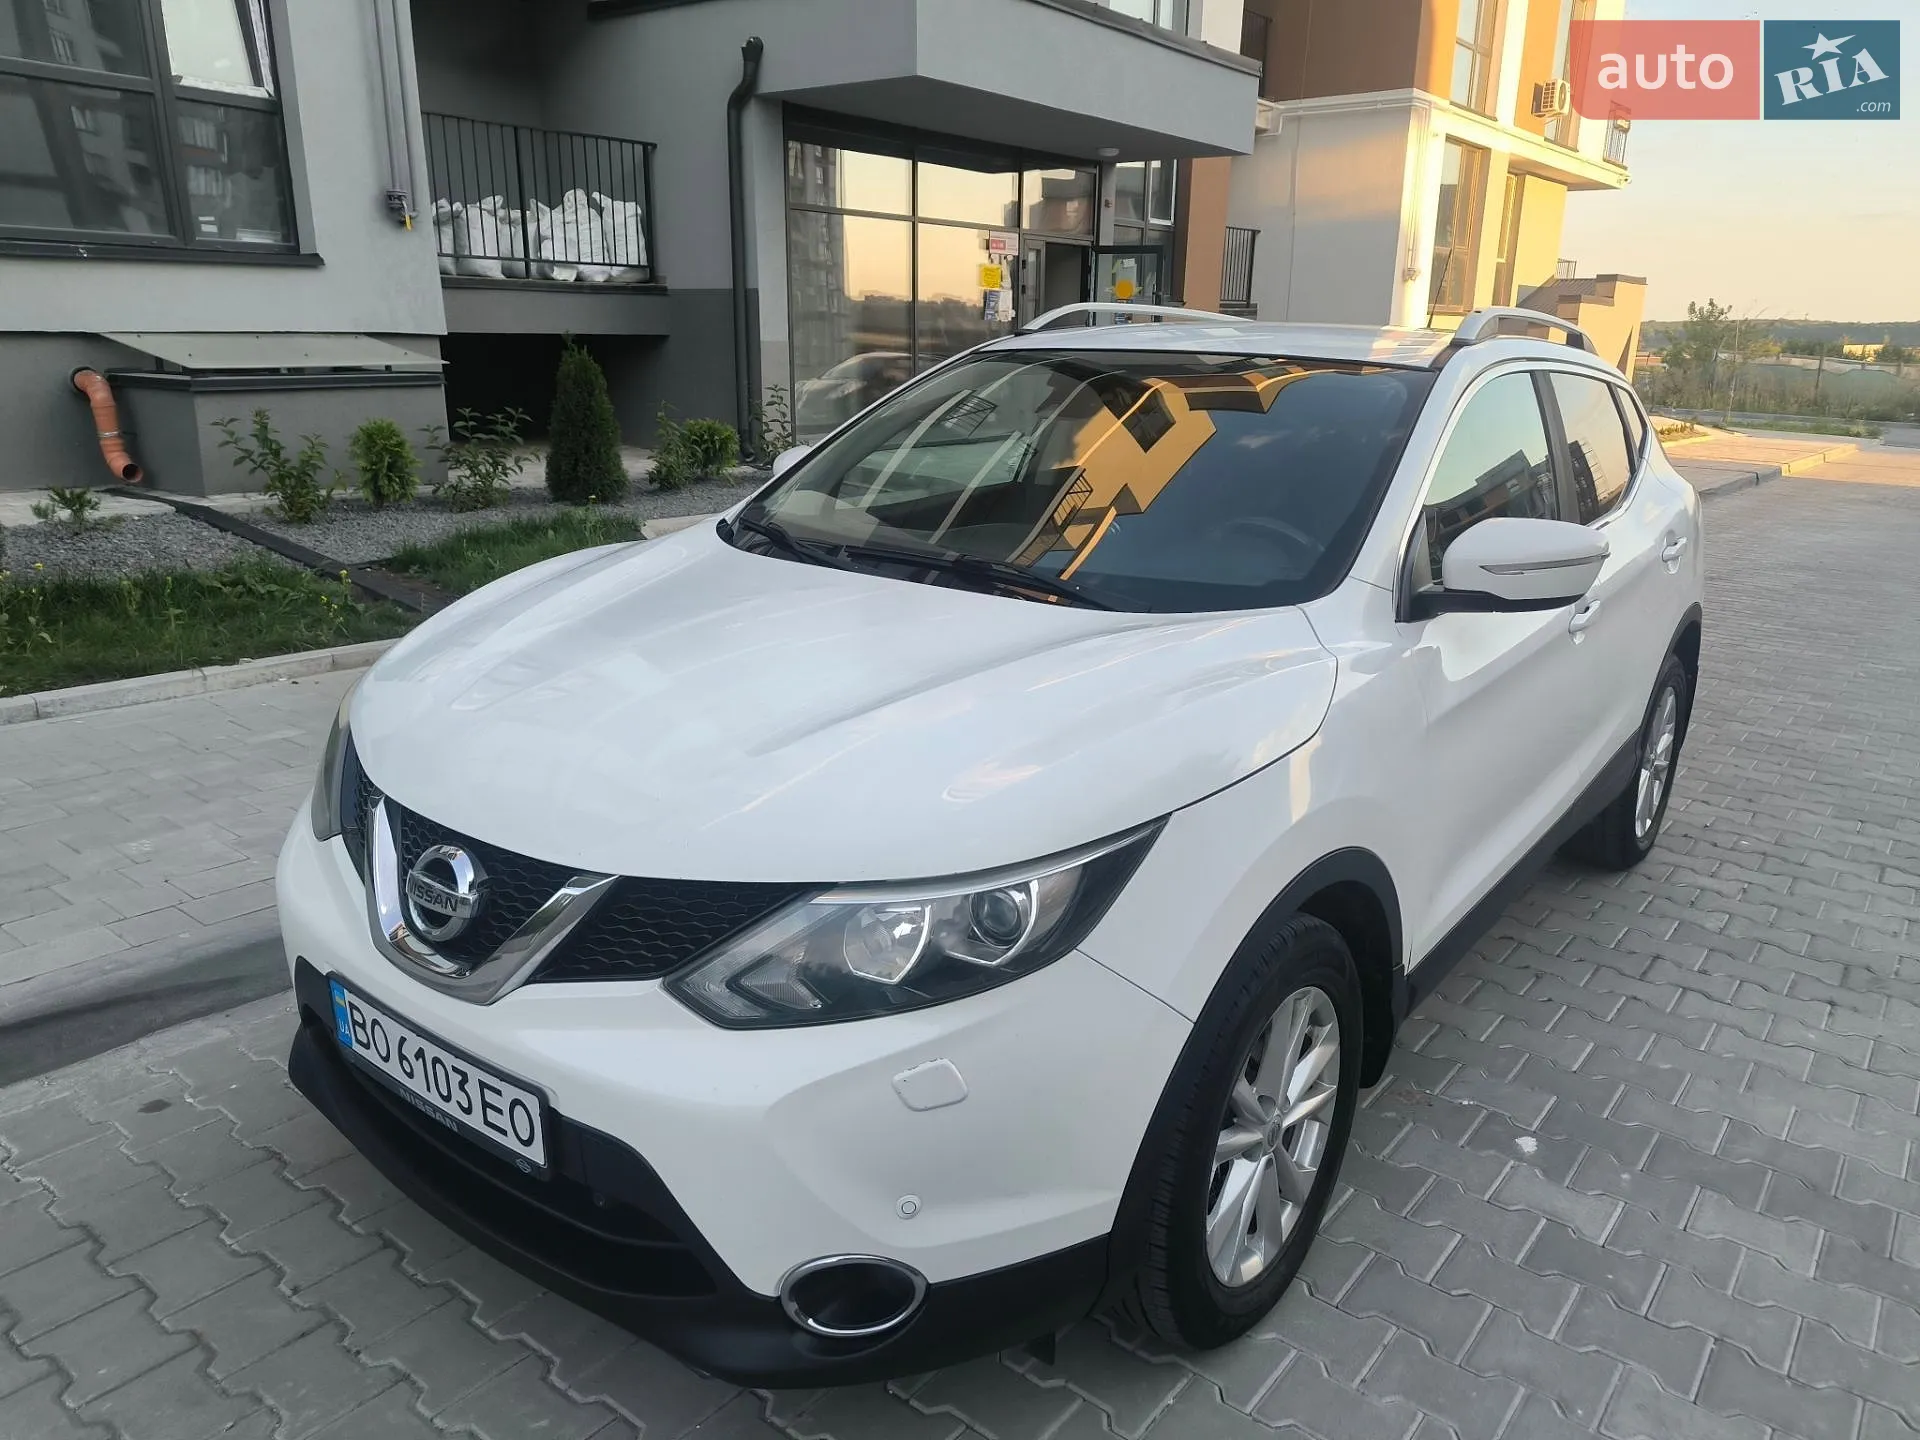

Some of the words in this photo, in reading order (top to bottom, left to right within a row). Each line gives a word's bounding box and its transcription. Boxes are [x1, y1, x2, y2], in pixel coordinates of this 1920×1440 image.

[348, 1000, 391, 1063] BO
[397, 1036, 473, 1116] 6103
[478, 1078, 535, 1148] EO
[400, 1088, 458, 1132] NISSAN
